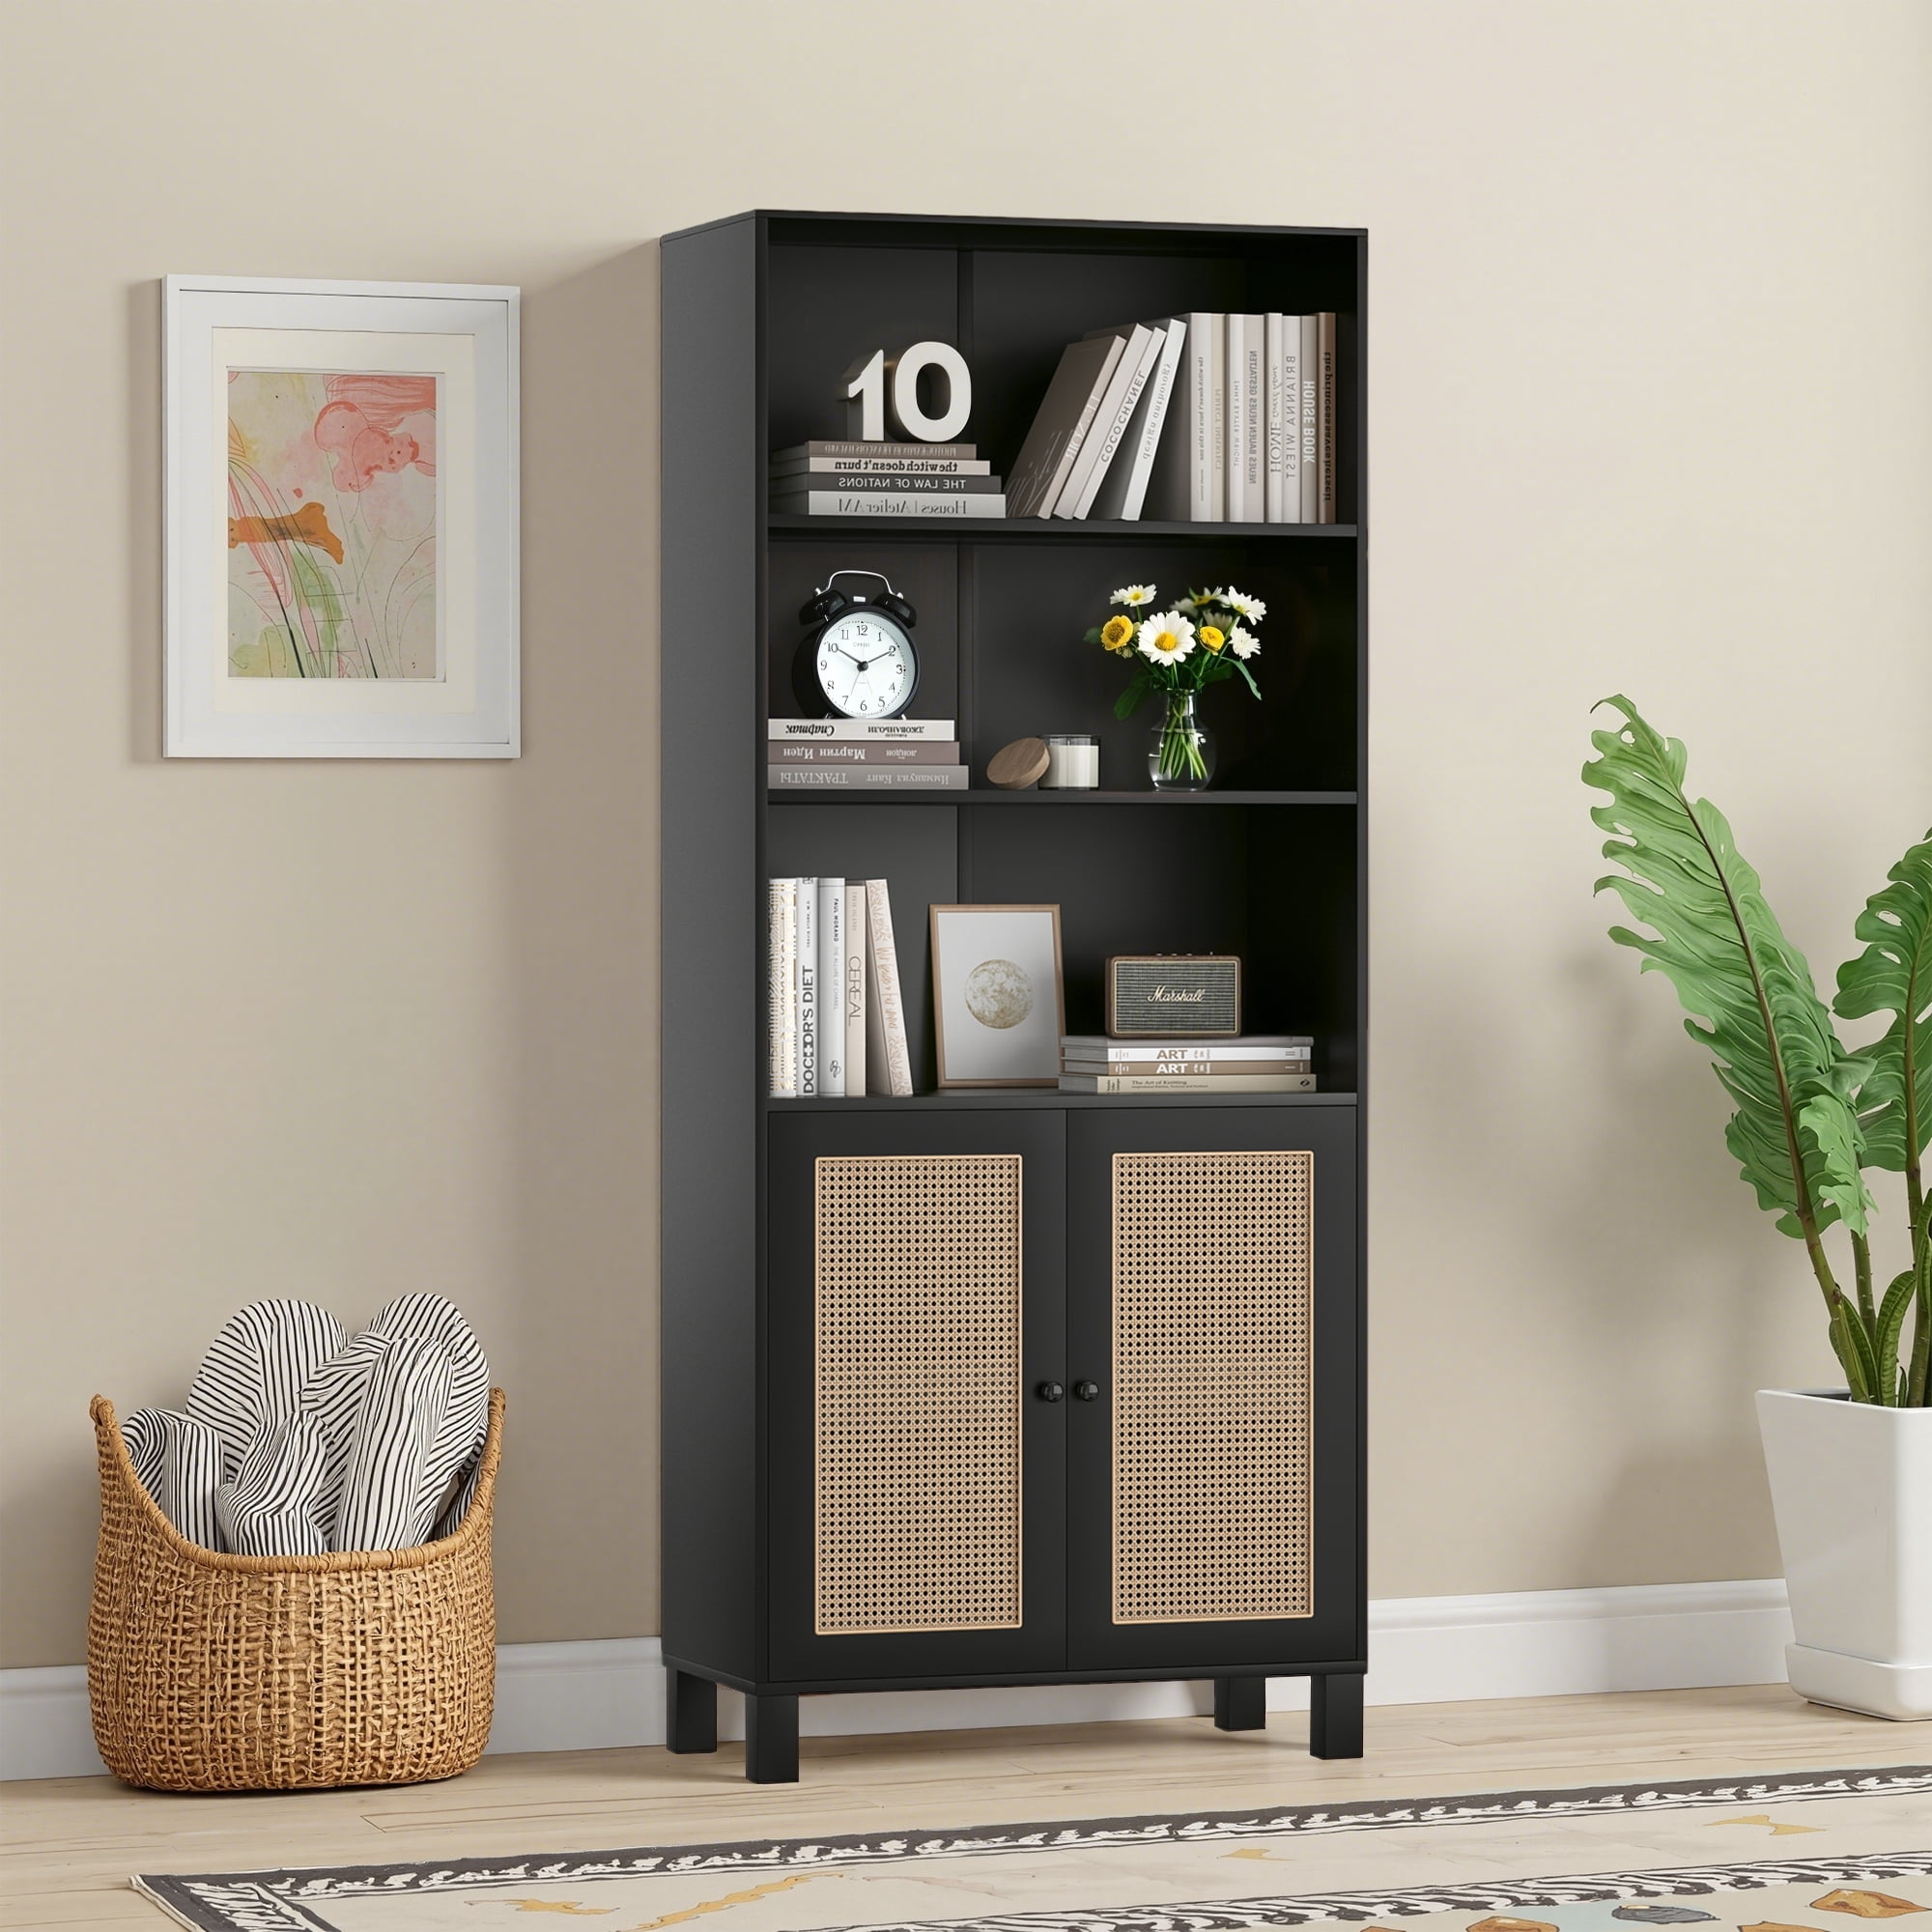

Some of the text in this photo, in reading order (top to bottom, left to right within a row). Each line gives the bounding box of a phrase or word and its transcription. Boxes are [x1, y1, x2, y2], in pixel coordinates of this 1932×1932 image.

[847, 341, 972, 442] 10
[857, 625, 867, 636] 12
[828, 642, 839, 653] 10
[889, 645, 895, 657] 2
[820, 660, 827, 670] 9
[896, 665, 903, 674] 3
[842, 696, 848, 705] 7
[860, 700, 867, 711] 6
[878, 696, 886, 707] 5
[785, 724, 835, 736] Спартак
[783, 746, 866, 759] Мартин Иден
[781, 772, 848, 783] ТРАКТАТЫ
[866, 774, 950, 784] Иммануил Кант
[802, 965, 813, 1003] DIET
[849, 955, 862, 1027] CEREAL
[1147, 984, 1206, 1003] Marshall
[1156, 1049, 1187, 1060] ART
[1156, 1063, 1187, 1074] ART
